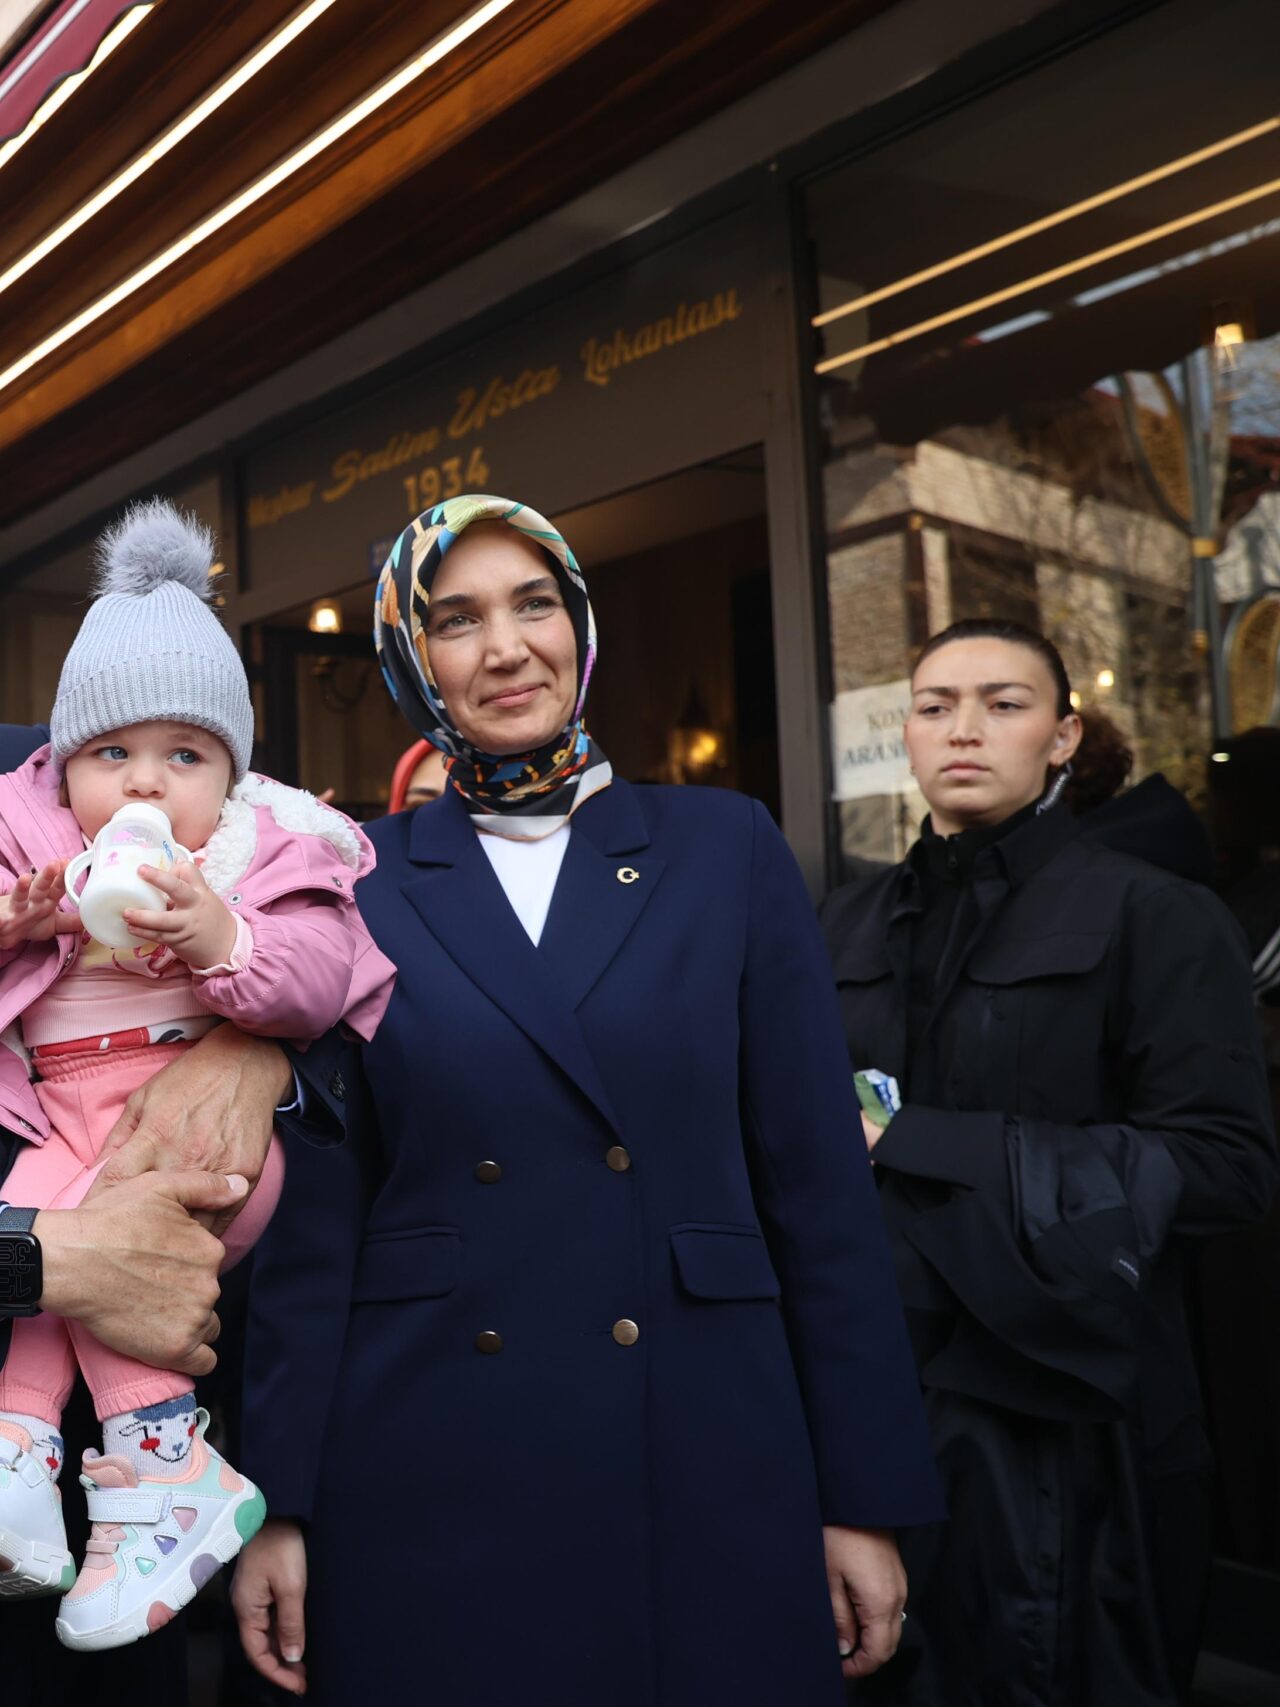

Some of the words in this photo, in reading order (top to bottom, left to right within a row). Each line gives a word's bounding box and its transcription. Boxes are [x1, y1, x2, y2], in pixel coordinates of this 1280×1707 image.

[321, 426, 439, 502] Salim
[448, 366, 558, 439] Usta
[404, 447, 489, 514] 1934
